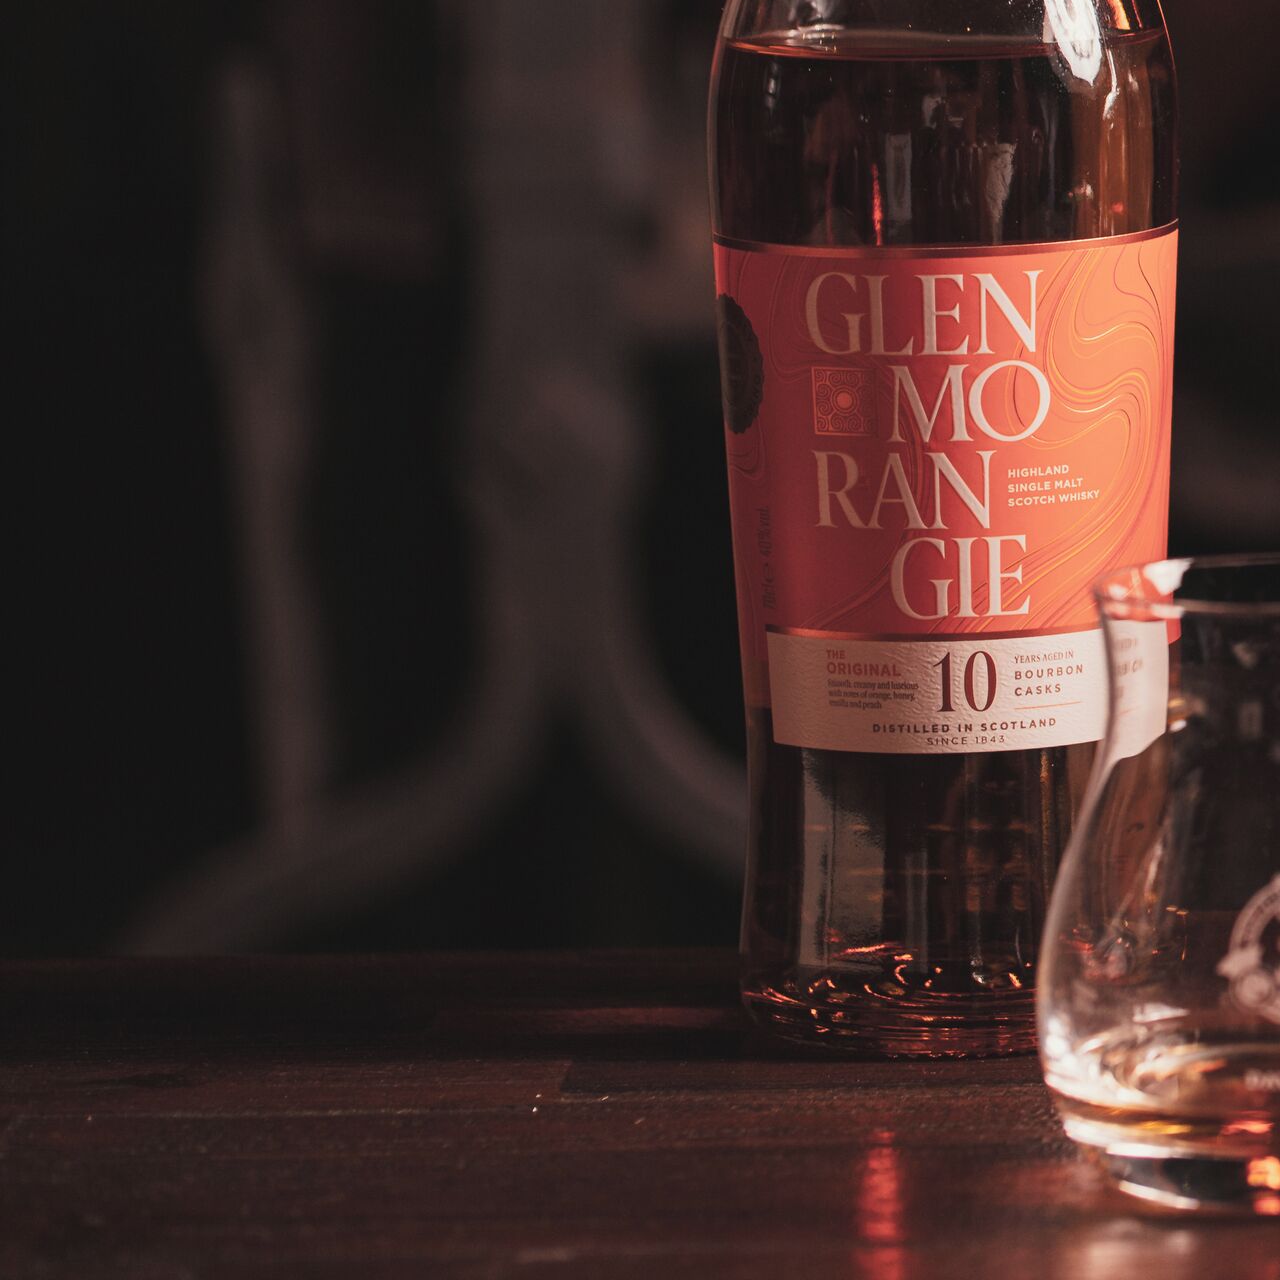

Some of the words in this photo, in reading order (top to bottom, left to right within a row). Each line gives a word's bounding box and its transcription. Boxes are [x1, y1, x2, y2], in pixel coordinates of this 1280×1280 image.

[805, 270, 1044, 356] GLEN
[886, 360, 1051, 442] MO
[1008, 464, 1070, 478] HIGHLAND
[812, 450, 998, 530] RAN
[1008, 480, 1050, 493] SINGLE
[1054, 478, 1084, 490] MALT
[1008, 495, 1056, 507] SCOTCH
[1059, 489, 1100, 503] WHISKY
[890, 534, 1031, 620] GIE
[826, 649, 846, 660] THE
[1014, 654, 1041, 664] YEARS
[1042, 652, 1063, 662] AGED
[1064, 650, 1074, 660] IN
[826, 662, 902, 677] ORIGINAL
[1014, 664, 1084, 680] BOURBON
[932, 650, 997, 713] 10
[1014, 684, 1062, 697] CASKS
[872, 722, 950, 734] DISTILLED
[957, 722, 974, 733] IN
[980, 718, 1056, 732] SCOTLAND
[926, 735, 968, 746] SINCE
[974, 734, 1006, 745] 1843
